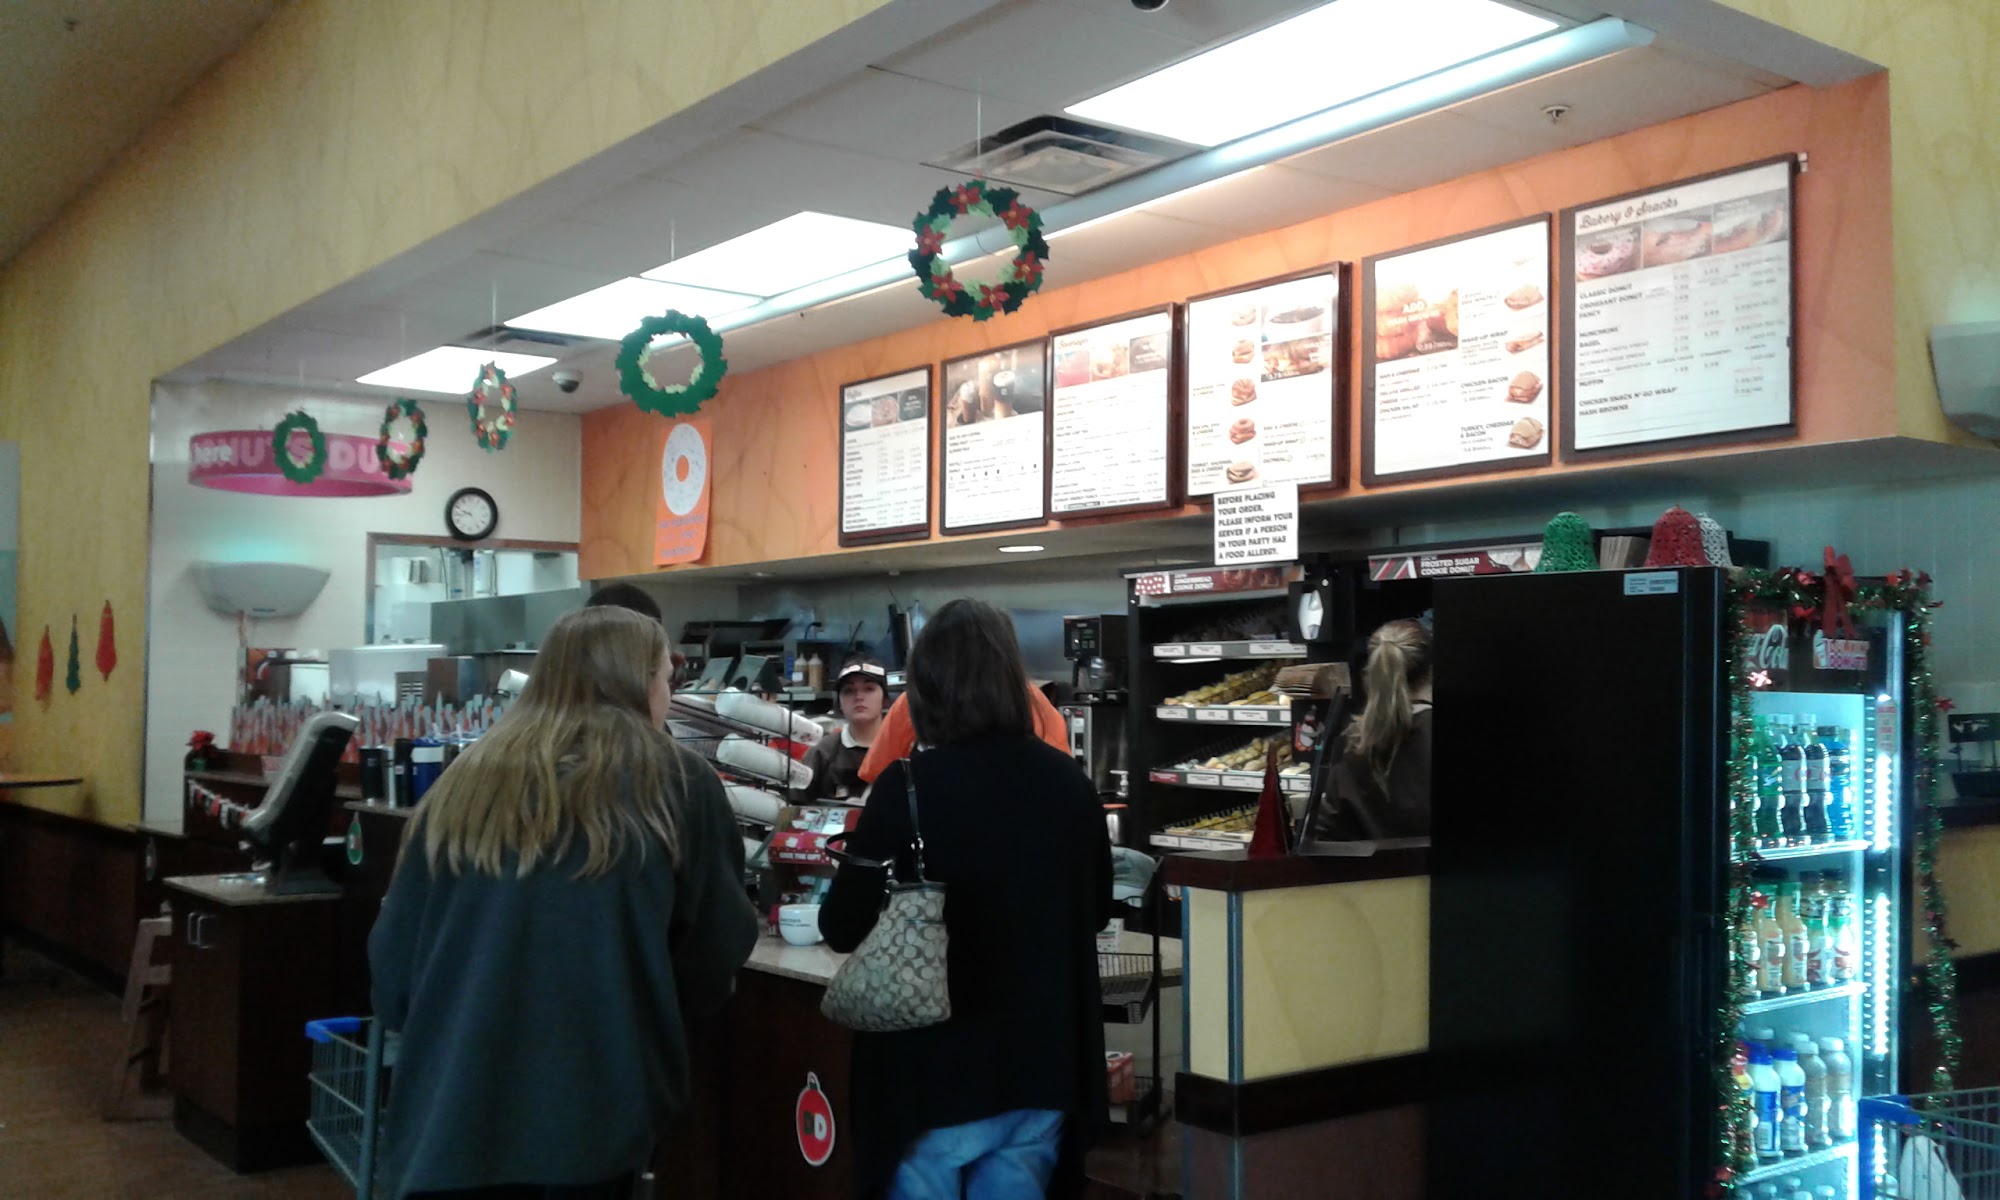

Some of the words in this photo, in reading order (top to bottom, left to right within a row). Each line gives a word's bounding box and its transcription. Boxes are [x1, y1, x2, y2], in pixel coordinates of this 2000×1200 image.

[1579, 288, 1607, 299] CLASSIC
[1608, 283, 1633, 294] DONUT
[1618, 292, 1643, 302] DONUT
[1578, 309, 1600, 318] FANCY
[1578, 340, 1600, 349] BAGEL
[1218, 495, 1242, 505] BEFORE
[1245, 491, 1275, 502] PLACING
[1218, 507, 1236, 516] YOUR
[1218, 517, 1243, 527] PLEASE
[1244, 514, 1272, 524] INFORM
[1274, 512, 1293, 521] YOUR
[1218, 528, 1243, 538] SERVER
[1245, 527, 1251, 535] IF
[1260, 524, 1288, 533] PERSON
[1218, 541, 1226, 549] IN
[1228, 539, 1247, 548] YOUR
[1248, 537, 1270, 546] PARTY
[1272, 535, 1287, 543] HAS
[1225, 550, 1245, 559] FOOD
[1247, 548, 1278, 557] ALLERGY.
[1421, 559, 1454, 569] FROSTED
[1454, 557, 1480, 566] SUGAR
[1421, 567, 1448, 576] COOKIE
[1449, 565, 1476, 574] DONUT
[1174, 583, 1194, 591] COOKIE
[1194, 582, 1214, 590] DONUT
